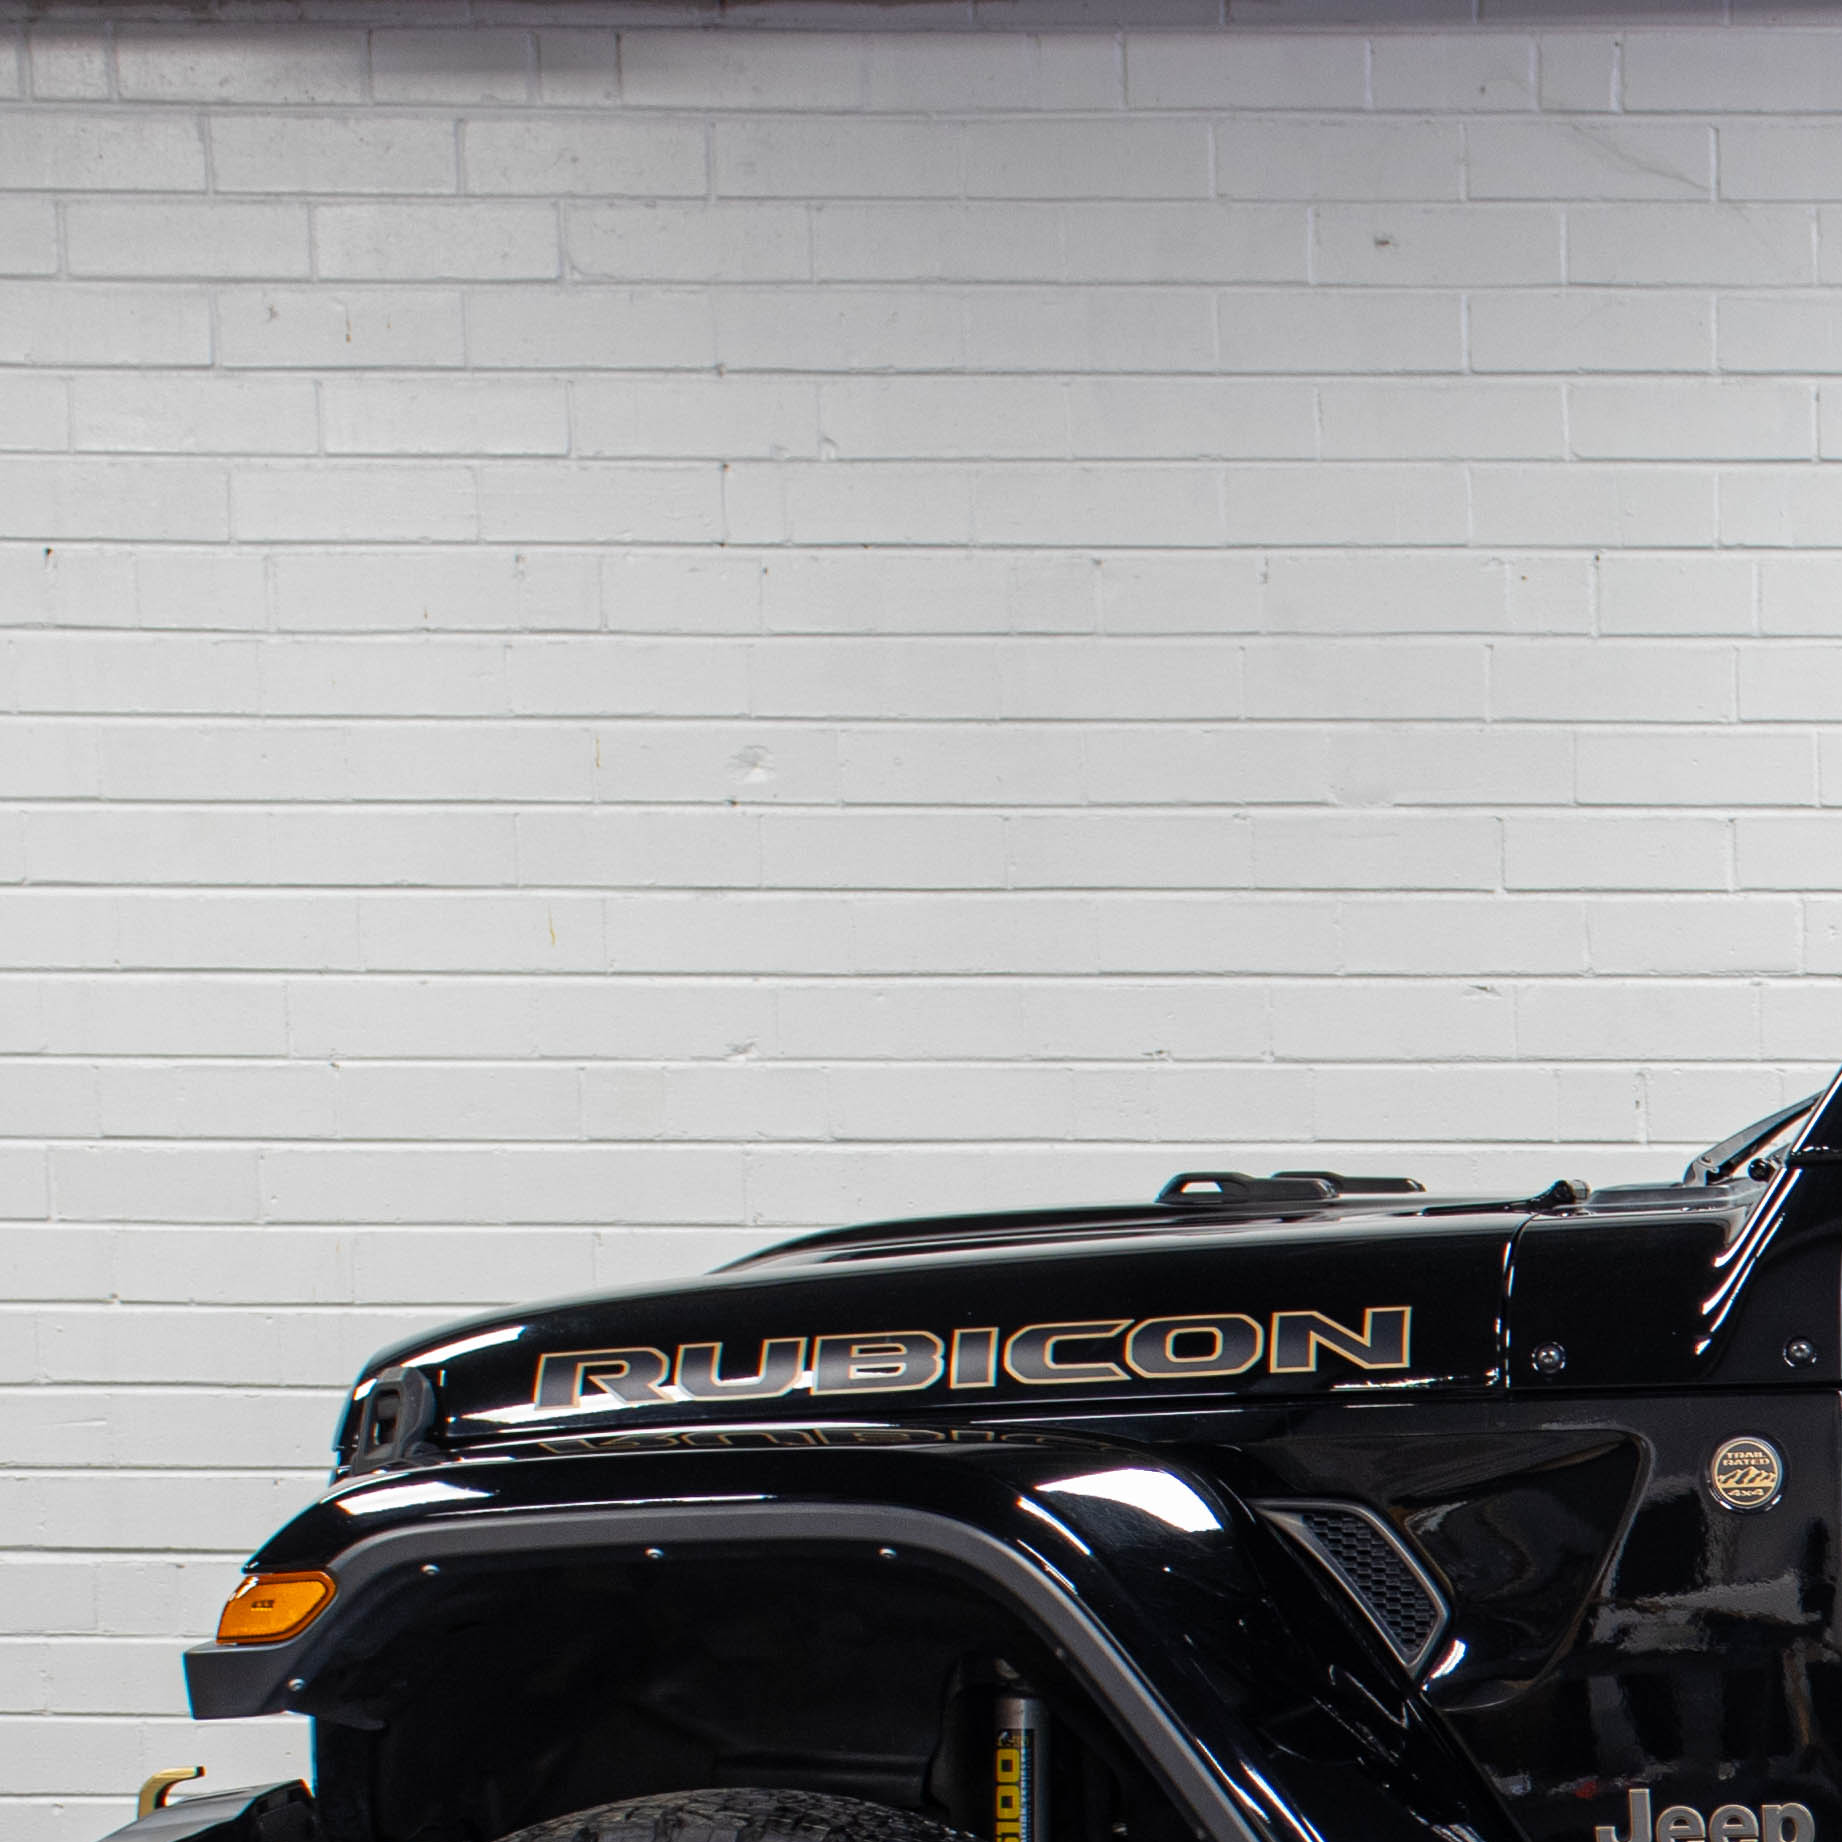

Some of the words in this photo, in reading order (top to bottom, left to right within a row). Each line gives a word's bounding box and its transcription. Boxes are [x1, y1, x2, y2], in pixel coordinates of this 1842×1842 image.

[532, 1306, 1413, 1408] RUBICON
[1726, 1451, 1766, 1459] TRAIL
[1722, 1459, 1770, 1467] RATED
[1727, 1488, 1765, 1497] 4x4
